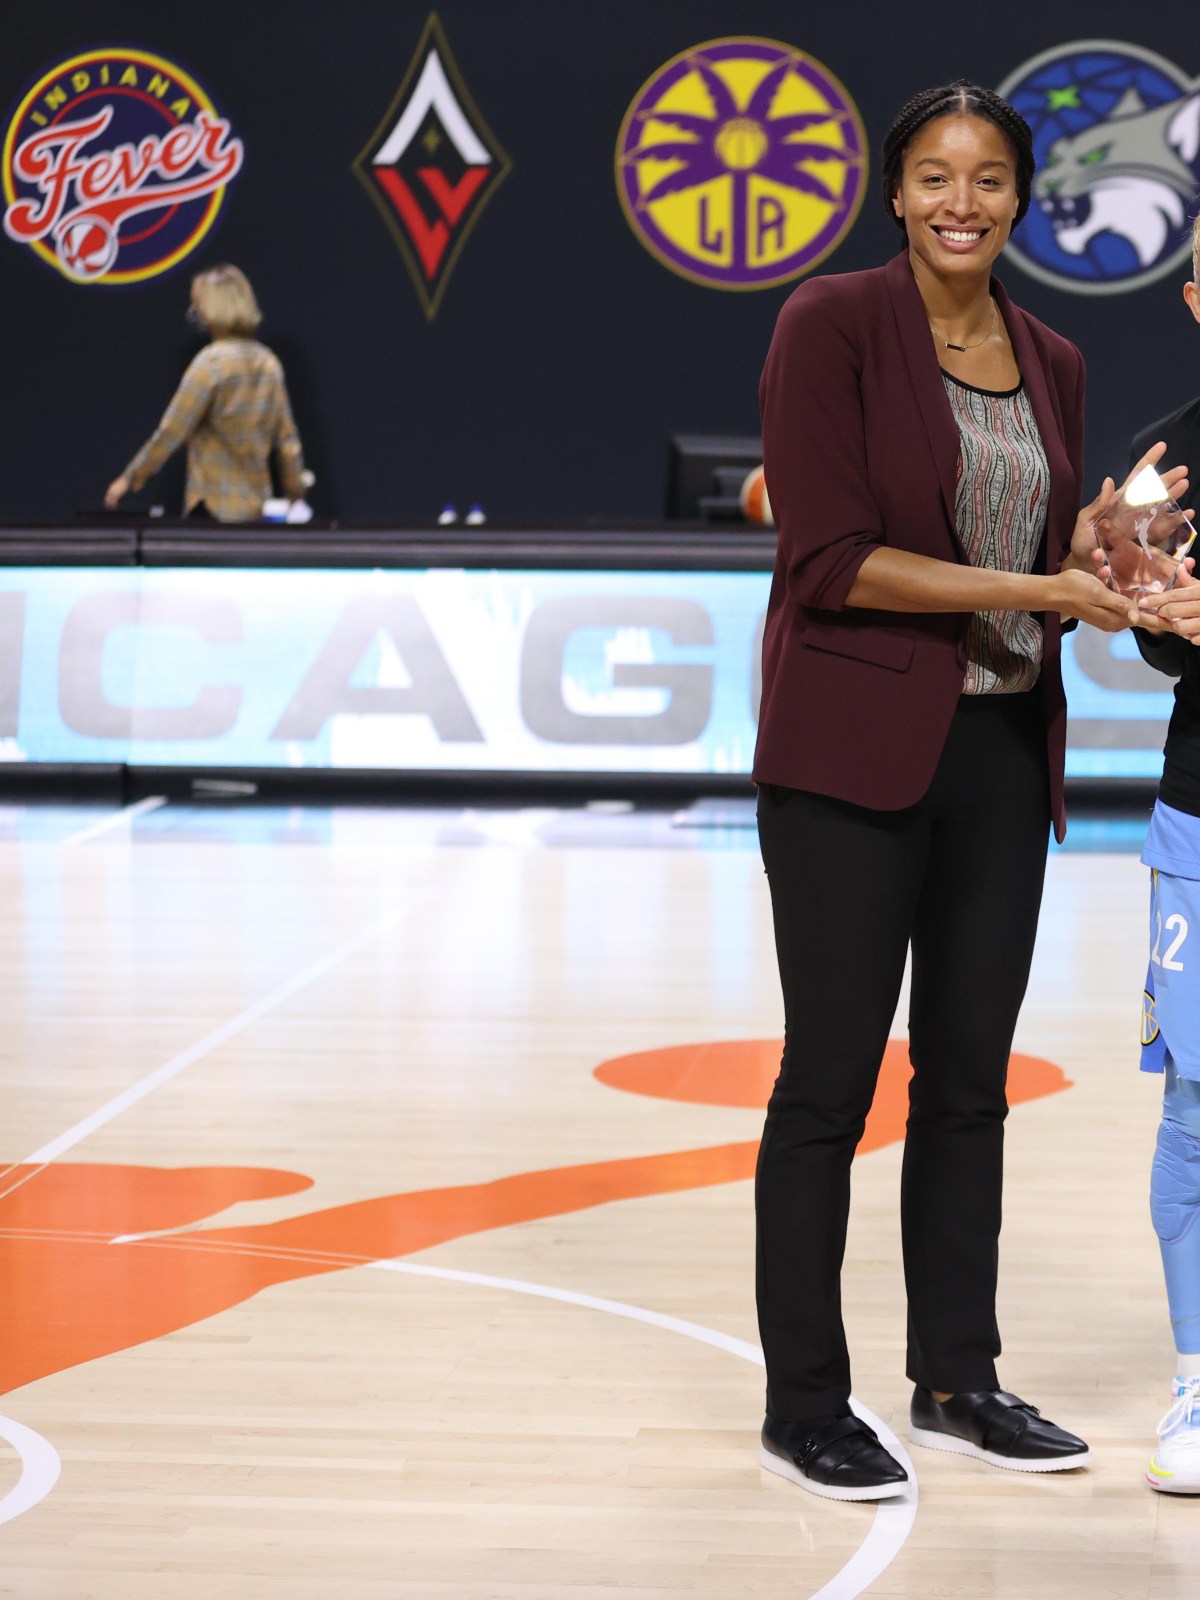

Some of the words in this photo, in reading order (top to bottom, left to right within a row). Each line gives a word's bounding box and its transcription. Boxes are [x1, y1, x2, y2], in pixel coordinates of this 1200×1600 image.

[30, 64, 191, 126] INDIANA
[4, 104, 244, 244] Fever
[1151, 910, 1188, 972] 22
